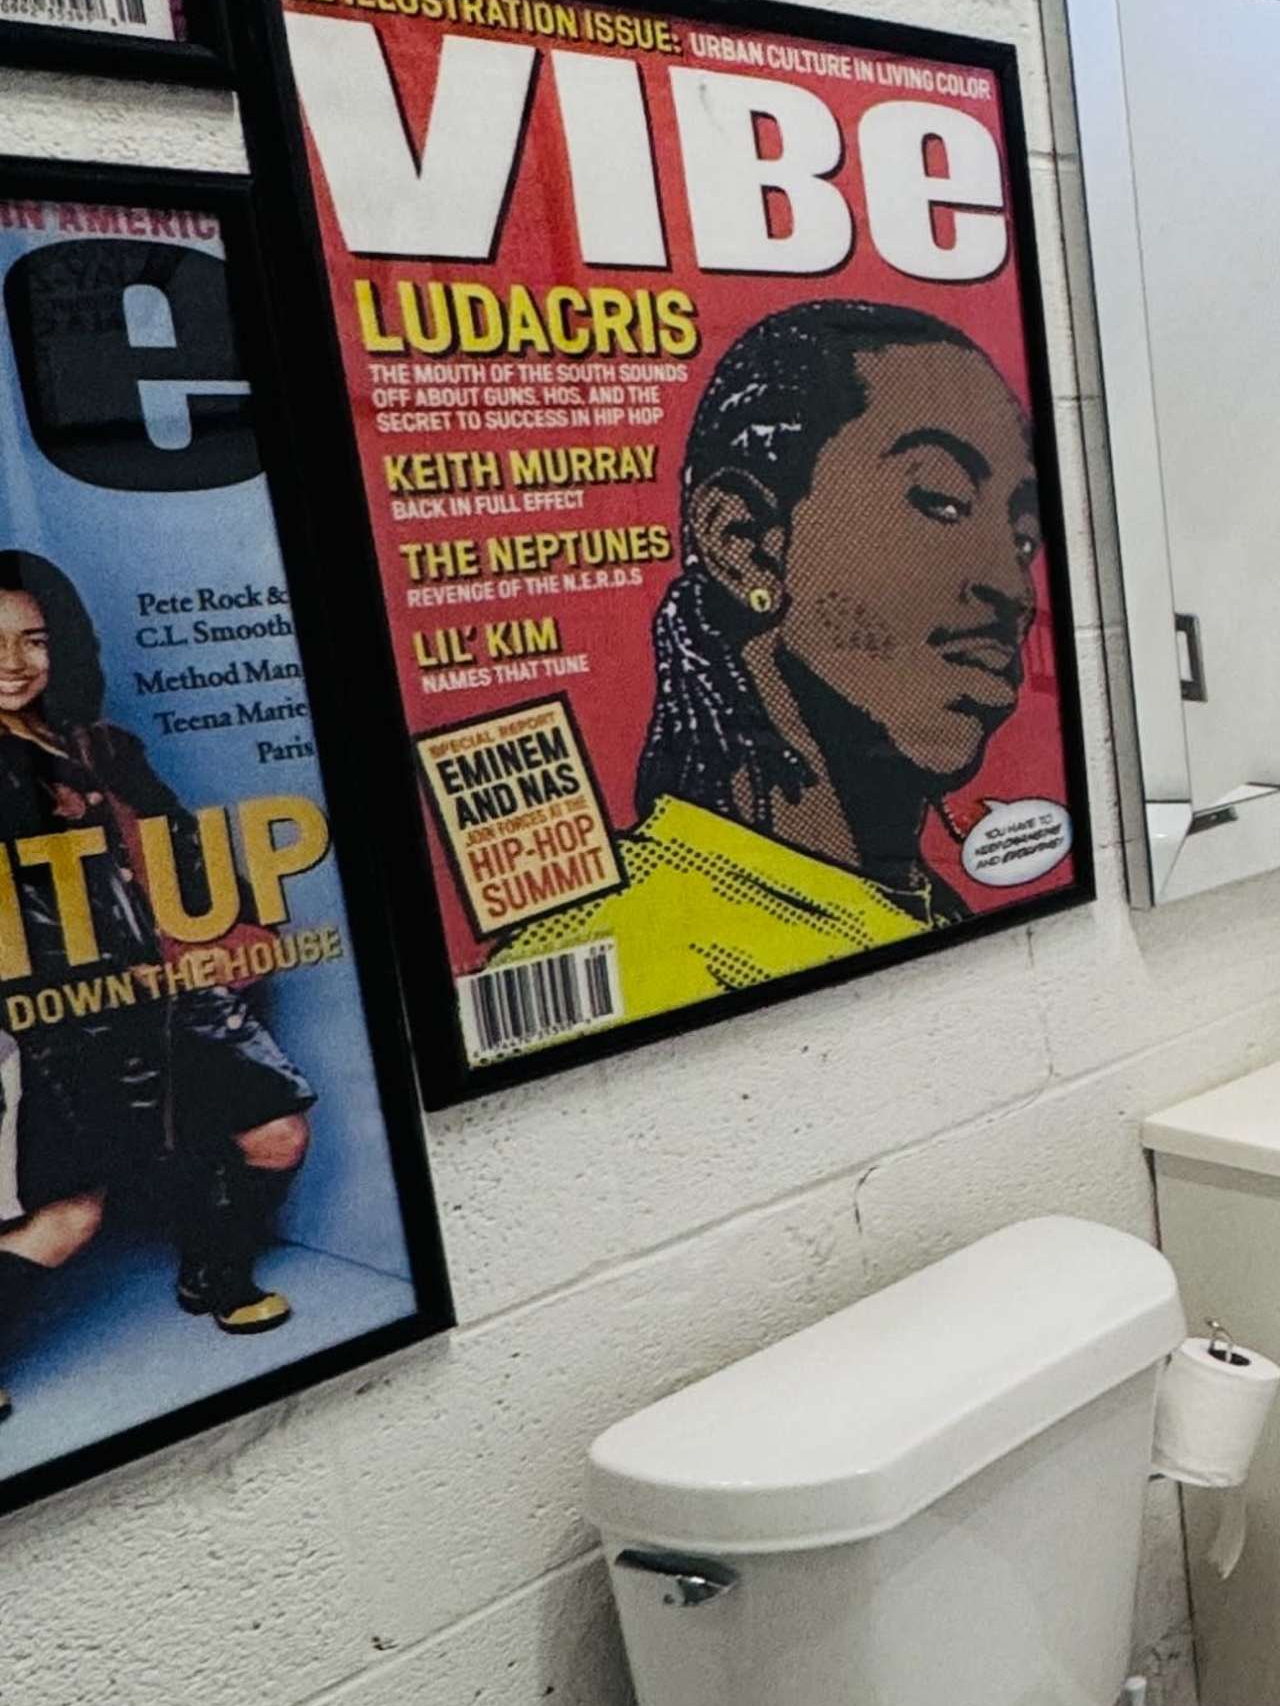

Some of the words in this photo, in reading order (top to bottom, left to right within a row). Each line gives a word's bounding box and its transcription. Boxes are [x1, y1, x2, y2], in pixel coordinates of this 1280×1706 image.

[584, 8, 683, 56] ISSUE:
[687, 31, 764, 67] URBAN
[765, 44, 852, 81] CULTURE
[853, 57, 875, 83] IN
[876, 61, 935, 93] LIVING
[935, 70, 993, 100] COLOR
[352, 279, 702, 359] LUDACRIS
[368, 363, 411, 385] THE
[413, 363, 487, 385] MOUTH
[489, 363, 515, 384] OF
[517, 362, 555, 384] THE
[556, 362, 617, 384] SOUTH
[618, 362, 689, 383] SOUNDS
[371, 387, 411, 409] OFF
[414, 386, 480, 409] ABOUT
[588, 385, 625, 406] AND
[627, 384, 661, 405] THE
[375, 410, 454, 434] SECRET
[457, 409, 482, 431] TO
[484, 408, 569, 431] SUCCESS
[570, 407, 591, 428] IN
[593, 407, 625, 427] HIP
[627, 406, 665, 427] HOP
[382, 449, 503, 494] KEITH
[508, 443, 661, 490] MURRAY
[391, 496, 448, 522] BACK
[450, 495, 473, 518] IN
[474, 493, 521, 517] FULL
[524, 488, 586, 514] EFFECT
[400, 538, 481, 581] THE
[486, 523, 673, 575] NEPTUNES
[135, 592, 196, 618] Pete
[198, 585, 264, 612] Rock
[266, 585, 290, 606] &
[406, 584, 496, 609] REVENGE
[498, 581, 522, 602] OF
[523, 576, 561, 599] THE
[563, 566, 644, 595] N.E.R.D.S
[135, 623, 189, 650] C.L.
[192, 614, 295, 645] Smooth
[412, 622, 479, 672] LIL'
[484, 615, 562, 660] KIM
[134, 663, 241, 696] Method
[243, 659, 302, 685] Man
[421, 665, 492, 695] NAMES
[495, 662, 541, 685] THAT
[543, 654, 591, 678] TUNE
[153, 705, 231, 737] Teena
[236, 695, 309, 727] Marie
[428, 731, 495, 760] SPECIAL
[497, 711, 556, 738] REPORT
[256, 733, 315, 766] Paris
[436, 725, 570, 797] EMINEM
[453, 781, 519, 831] AND
[517, 761, 582, 809] NAS
[135, 794, 332, 946] UP
[466, 813, 596, 884] HIP-HOP
[481, 846, 608, 919] SUMMIT
[6, 977, 137, 1032] DOWN
[134, 950, 222, 1001] THE
[224, 925, 345, 981] HOUSE
